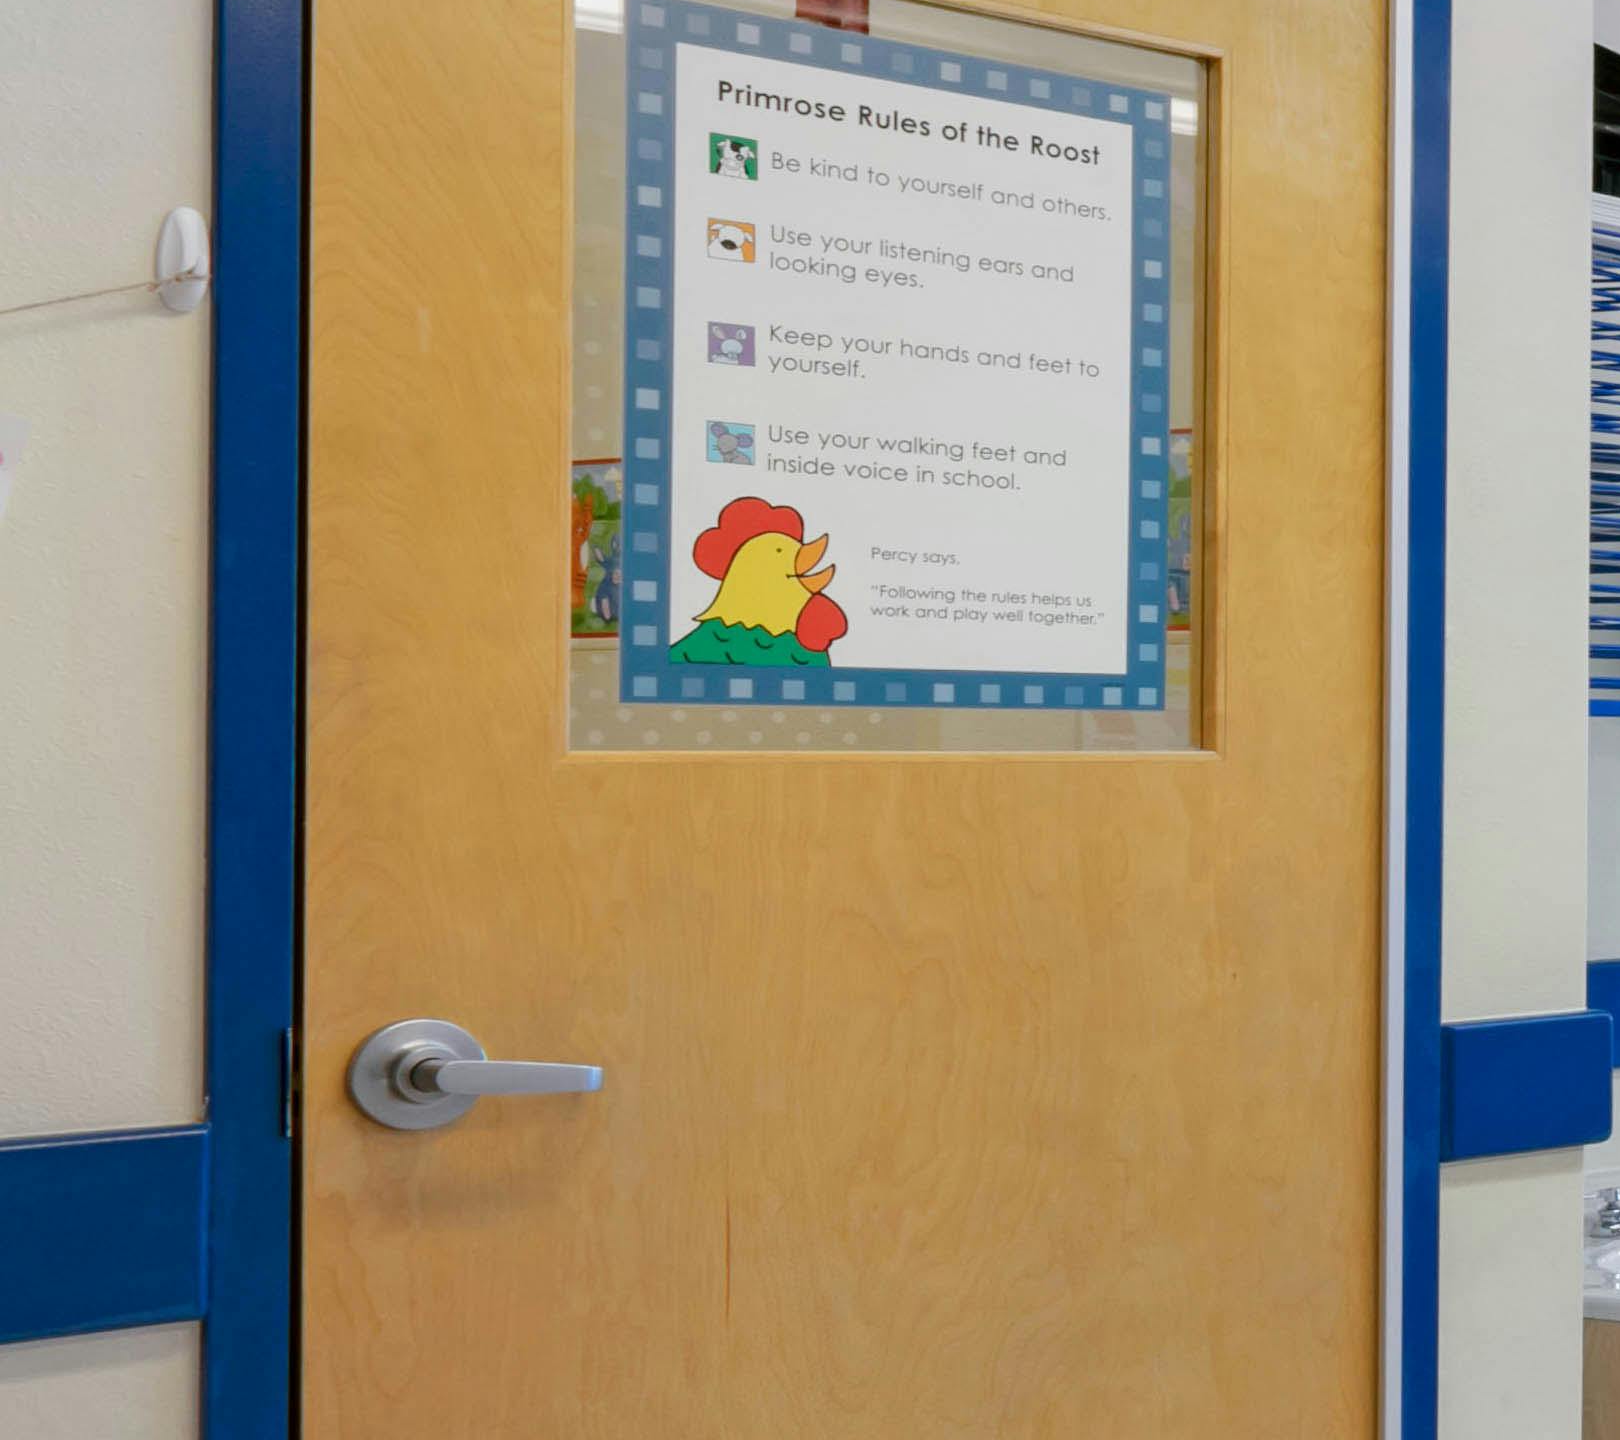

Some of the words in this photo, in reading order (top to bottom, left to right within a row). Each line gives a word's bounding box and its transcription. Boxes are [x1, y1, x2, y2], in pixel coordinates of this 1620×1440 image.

[718, 80, 846, 122] Primrose
[858, 105, 931, 137] Rules
[942, 122, 967, 143] of
[977, 127, 1020, 151] the
[1031, 135, 1101, 166] Roost
[771, 152, 801, 173] Be
[810, 157, 858, 182] kind
[867, 166, 890, 186] to
[897, 174, 984, 201] yourself
[991, 185, 1034, 209] and
[1042, 197, 1112, 222] others.
[770, 224, 812, 248] Use
[820, 231, 872, 256] your
[880, 239, 971, 272] listening
[978, 255, 1024, 278] ears
[1031, 259, 1074, 283] and
[770, 252, 857, 283] looking
[865, 268, 925, 289] eyes.
[768, 353, 867, 379] yourself.
[769, 325, 833, 351] Keep
[840, 335, 893, 356] your
[900, 339, 970, 364] hands
[977, 349, 1021, 369] and
[1029, 353, 1071, 374] feet
[1079, 360, 1100, 378] to
[768, 424, 809, 445] Use
[818, 430, 870, 450] your
[876, 436, 964, 462] walking
[972, 441, 1016, 463] feet
[1024, 449, 1067, 467] and
[767, 453, 835, 476] inside
[844, 461, 908, 482] voice
[916, 464, 935, 485] in
[942, 469, 1021, 491] school.
[871, 547, 917, 564] Percy
[922, 550, 960, 566] says,
[870, 584, 955, 604] "Following
[961, 588, 987, 603] the
[992, 591, 1026, 605] rules
[1032, 592, 1072, 608] helps
[1076, 596, 1092, 608] us
[870, 603, 909, 618] work
[915, 606, 948, 620] and
[953, 607, 988, 623] play
[992, 609, 1024, 623] well
[1029, 610, 1105, 627] together."
